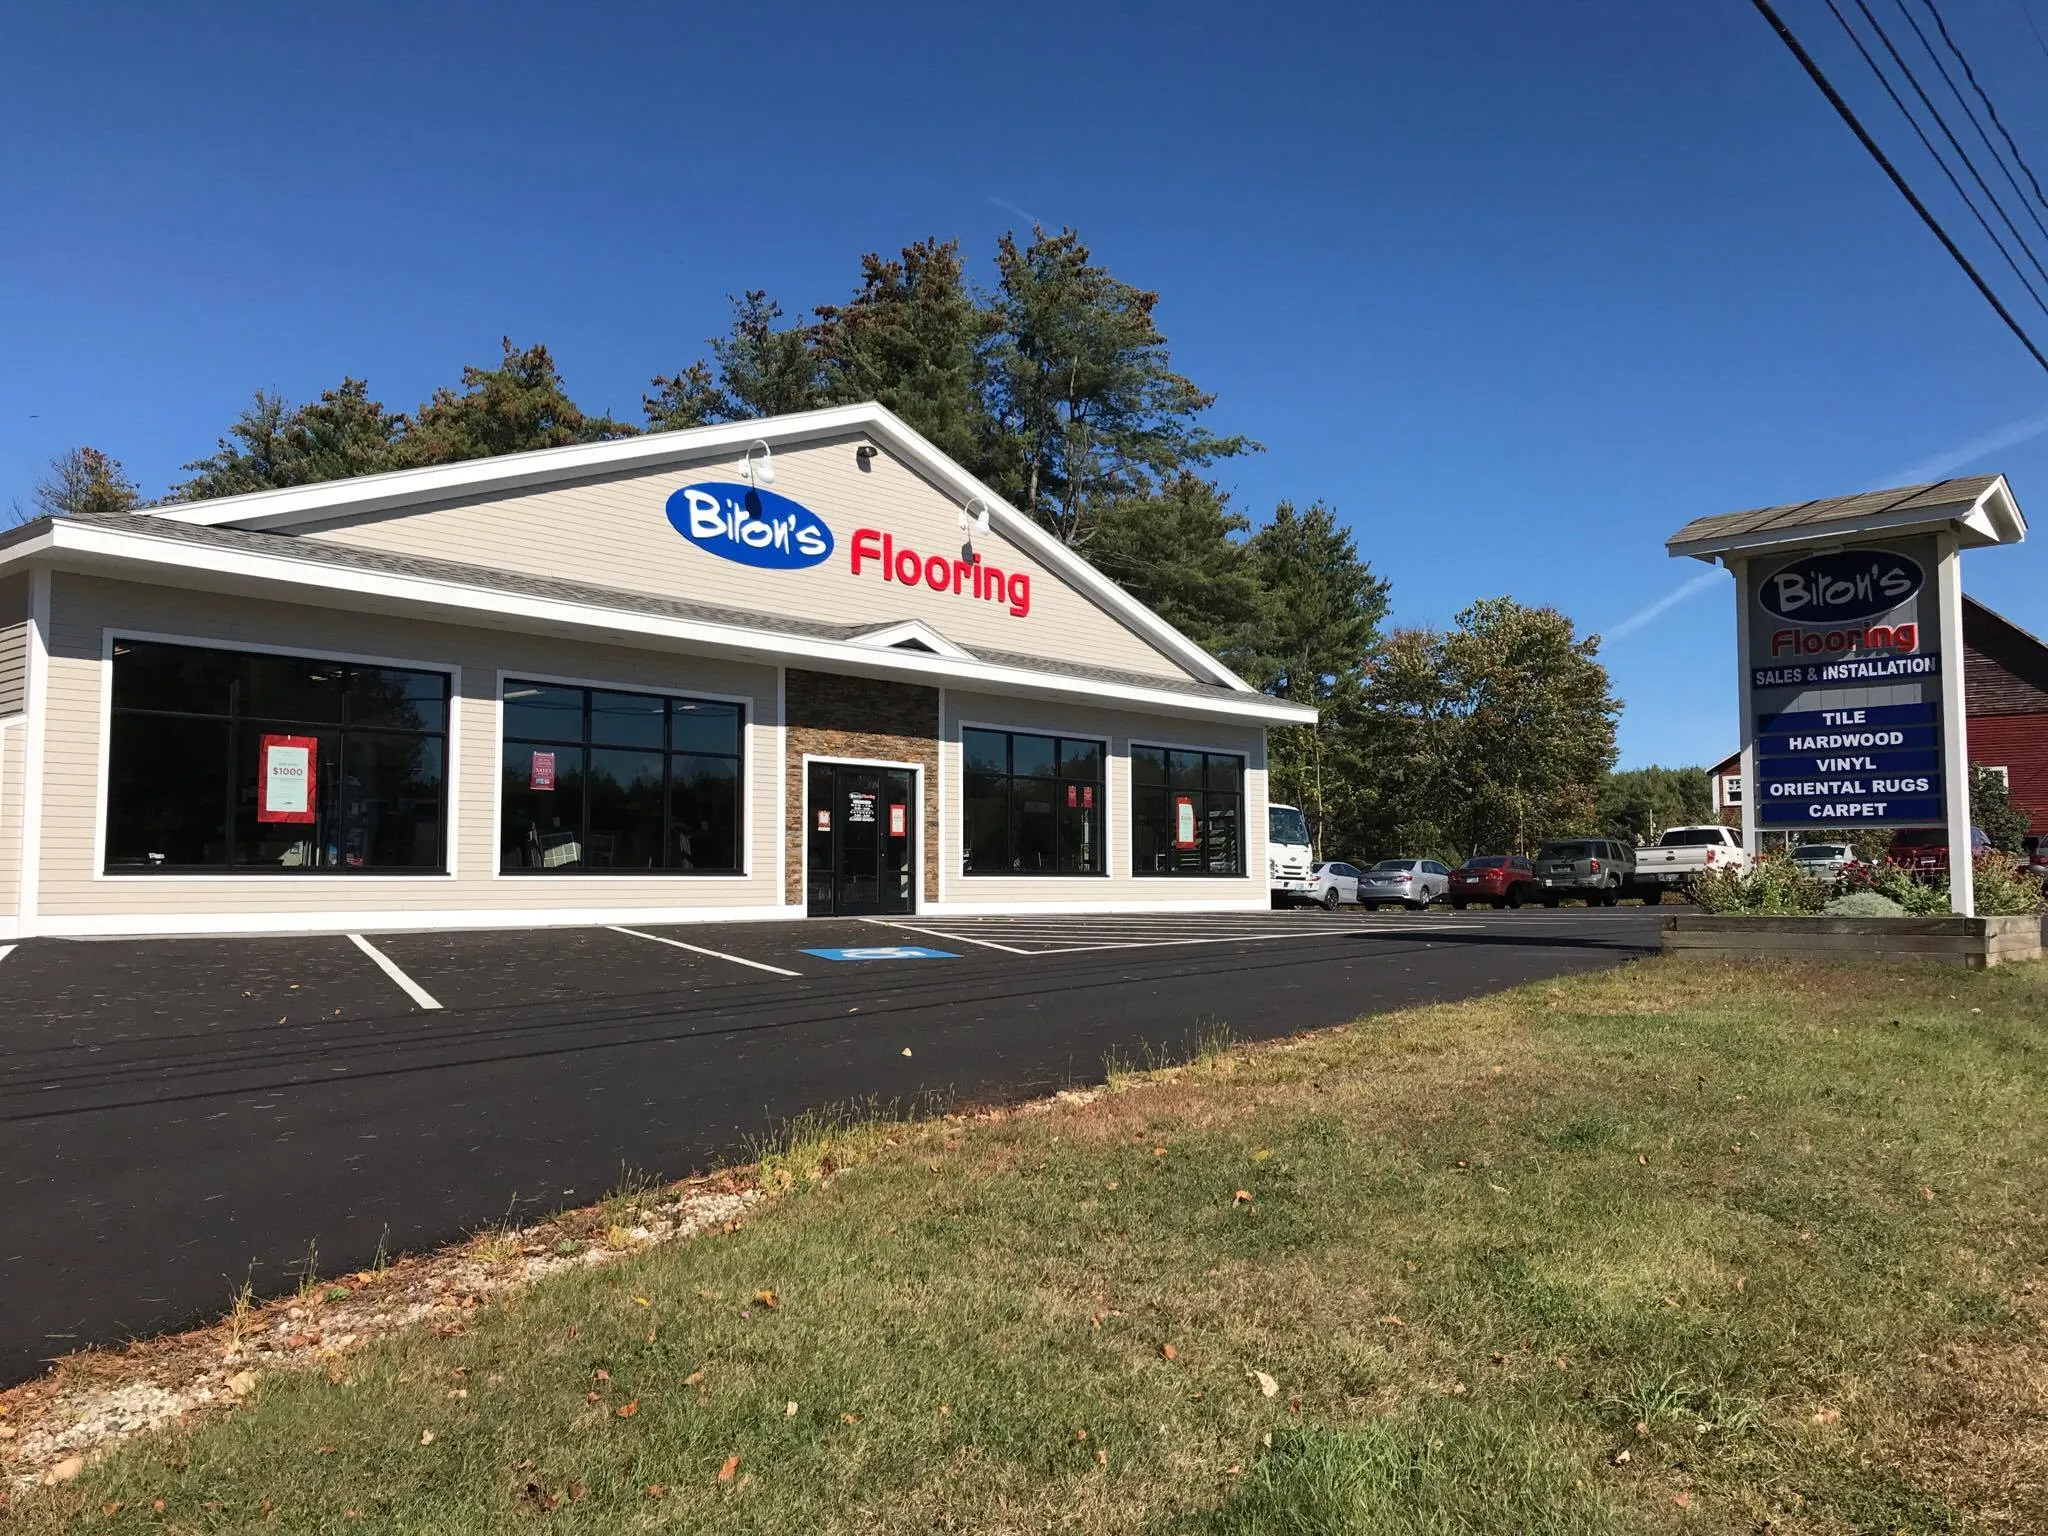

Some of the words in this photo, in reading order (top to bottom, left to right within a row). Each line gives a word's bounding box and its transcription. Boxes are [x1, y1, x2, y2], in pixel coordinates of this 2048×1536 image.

[684, 489, 826, 556] Biron's
[850, 528, 1031, 618] Flooring
[1774, 563, 1911, 613] Biron's
[1772, 622, 1918, 657] Flooring
[1756, 668, 1802, 685] SALES
[1807, 667, 1818, 681] &
[1823, 657, 1936, 680] INSTALLATION
[1822, 711, 1866, 725] TILE
[1789, 732, 1904, 750] HARDWOOD
[272, 766, 303, 776] $1000
[1816, 757, 1877, 772] VINYL
[1770, 780, 1866, 796] ORIENTAL
[1872, 778, 1929, 793] RUGS
[1809, 802, 1887, 818] CARPET
